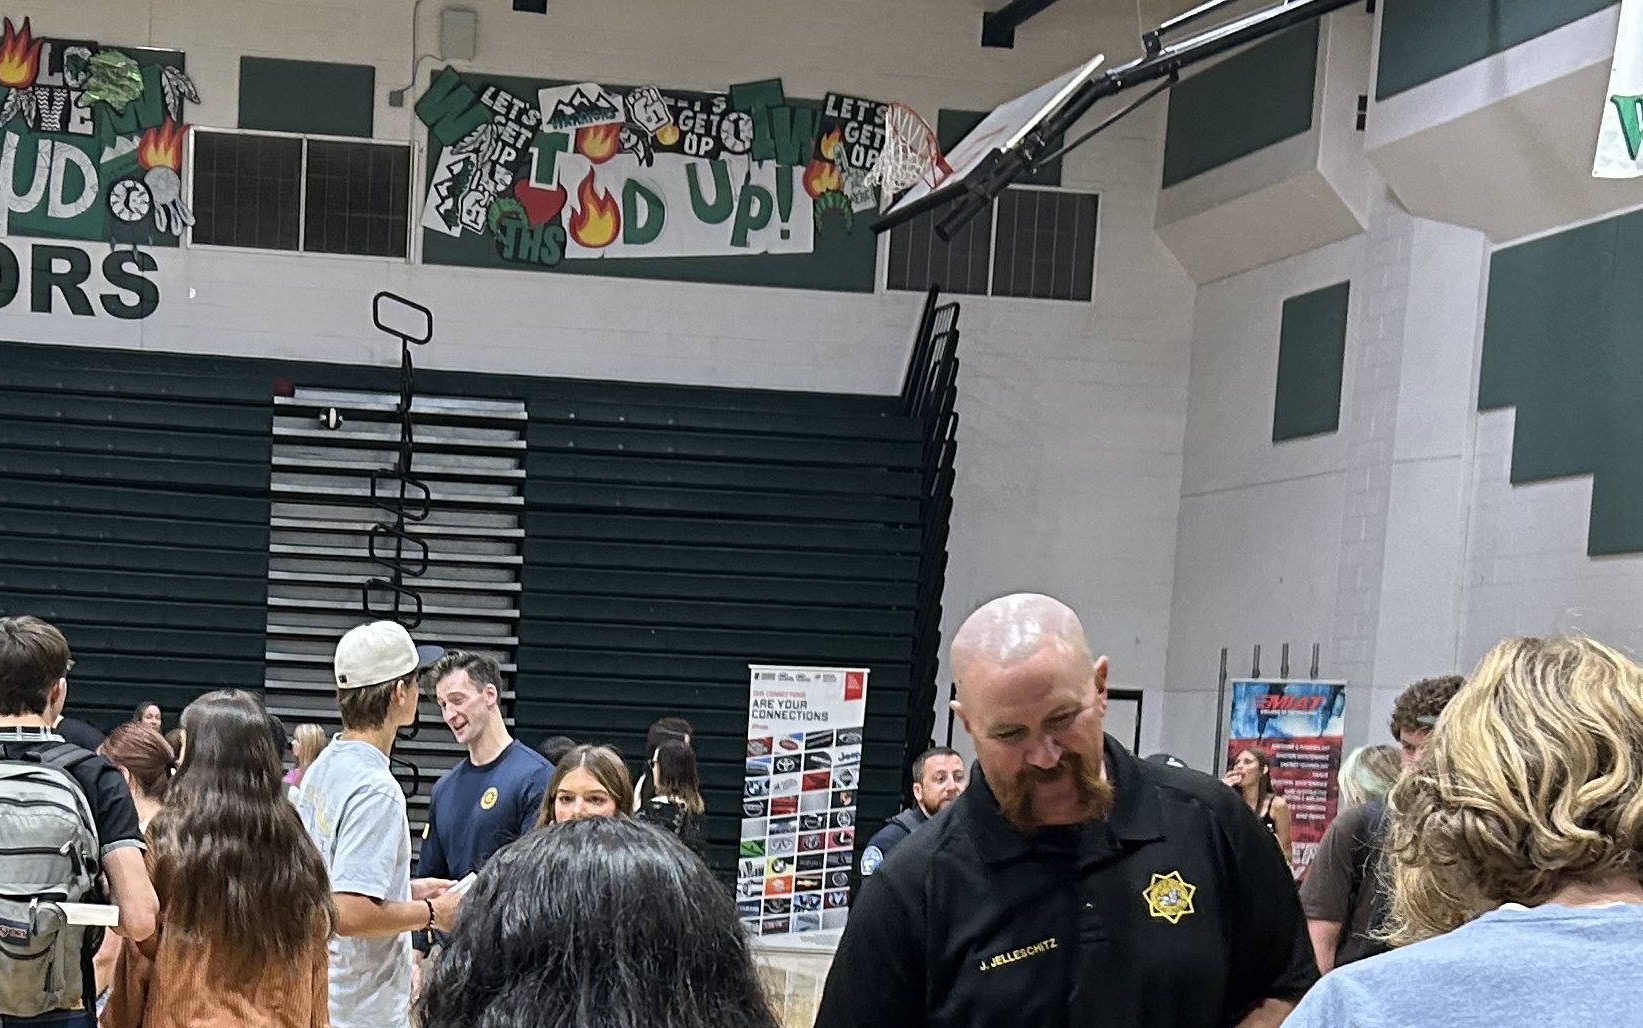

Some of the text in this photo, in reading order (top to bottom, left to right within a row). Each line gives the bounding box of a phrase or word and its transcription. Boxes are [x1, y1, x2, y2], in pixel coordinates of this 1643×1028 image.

[481, 86, 543, 126] LET'S
[826, 95, 887, 124] LET'S
[679, 110, 720, 136] GET
[845, 121, 886, 150] GET
[502, 218, 564, 266] THS
[751, 709, 829, 722] CONNECTIONS
[753, 699, 807, 710] ARE YOUR
[979, 960, 989, 971] J.
